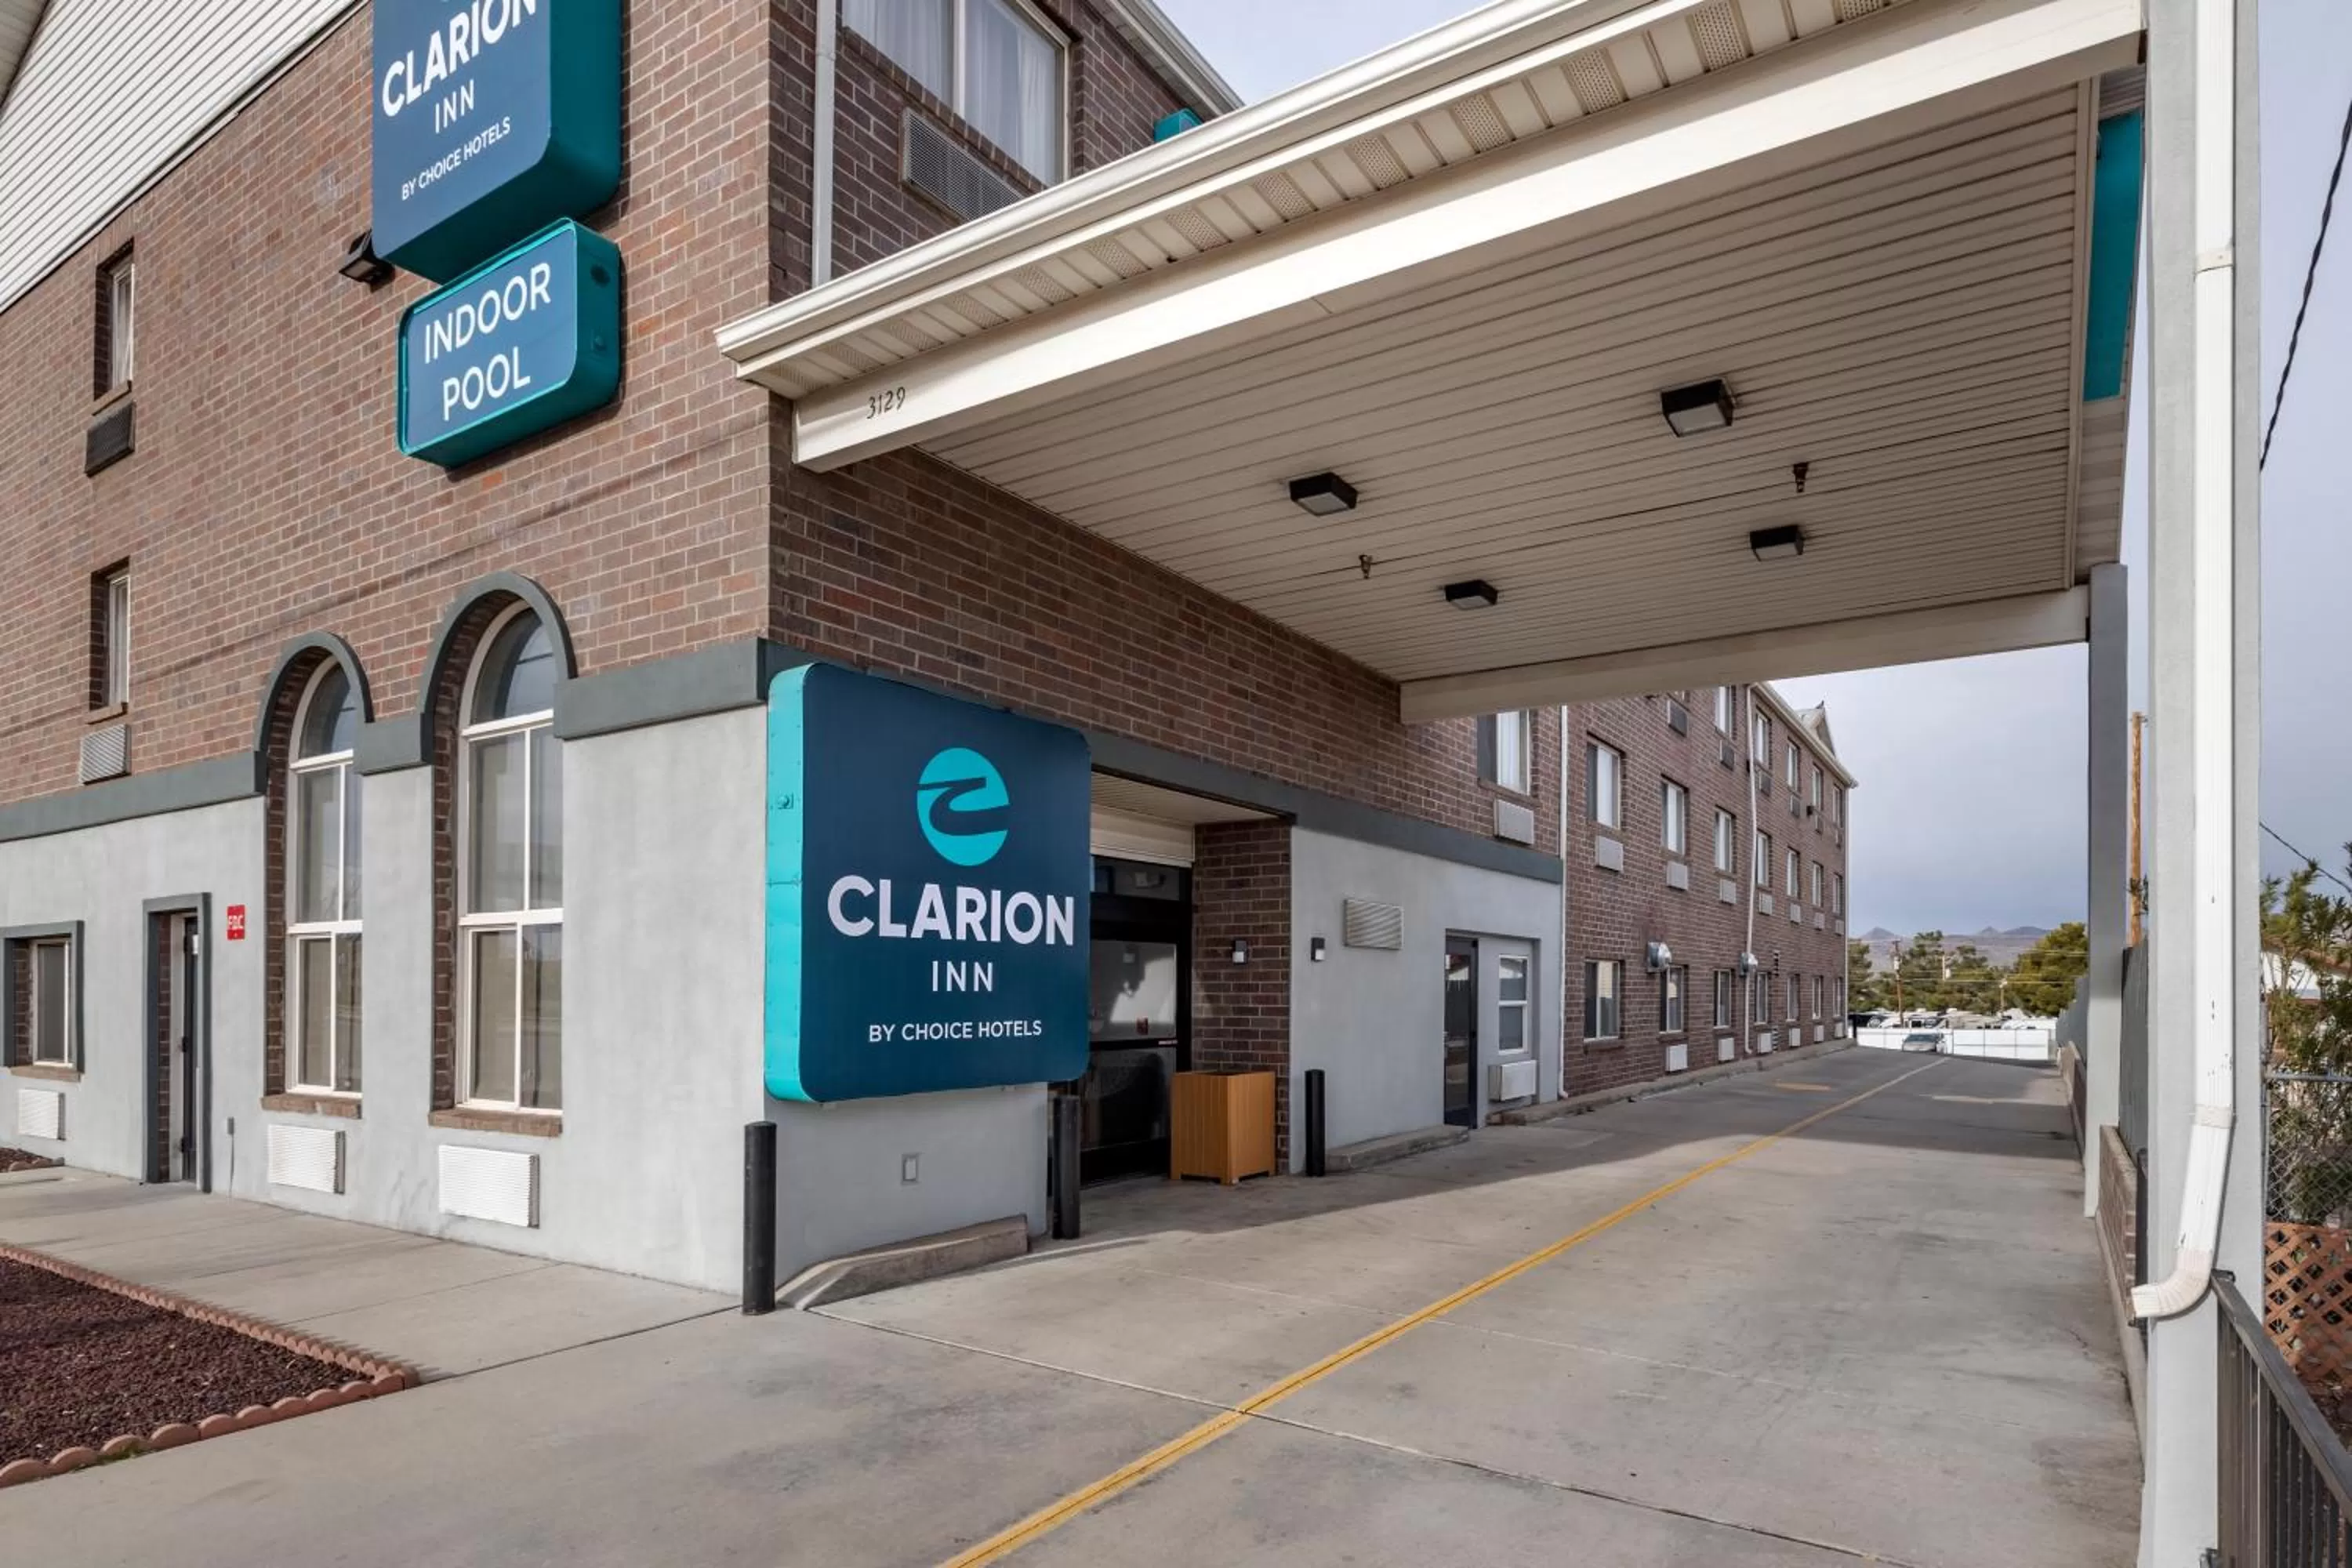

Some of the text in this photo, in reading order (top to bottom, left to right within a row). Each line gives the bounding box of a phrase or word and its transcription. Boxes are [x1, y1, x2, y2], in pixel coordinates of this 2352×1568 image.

[434, 79, 474, 134] INN
[401, 116, 510, 201] BY CHOICE HOTELS
[424, 263, 550, 364] INDOOR
[442, 346, 531, 421] POOL
[866, 387, 906, 419] 3129
[827, 874, 1075, 946] CLARION
[931, 960, 993, 992] INN
[869, 1020, 1043, 1042] BY CHOICE HOTELS
